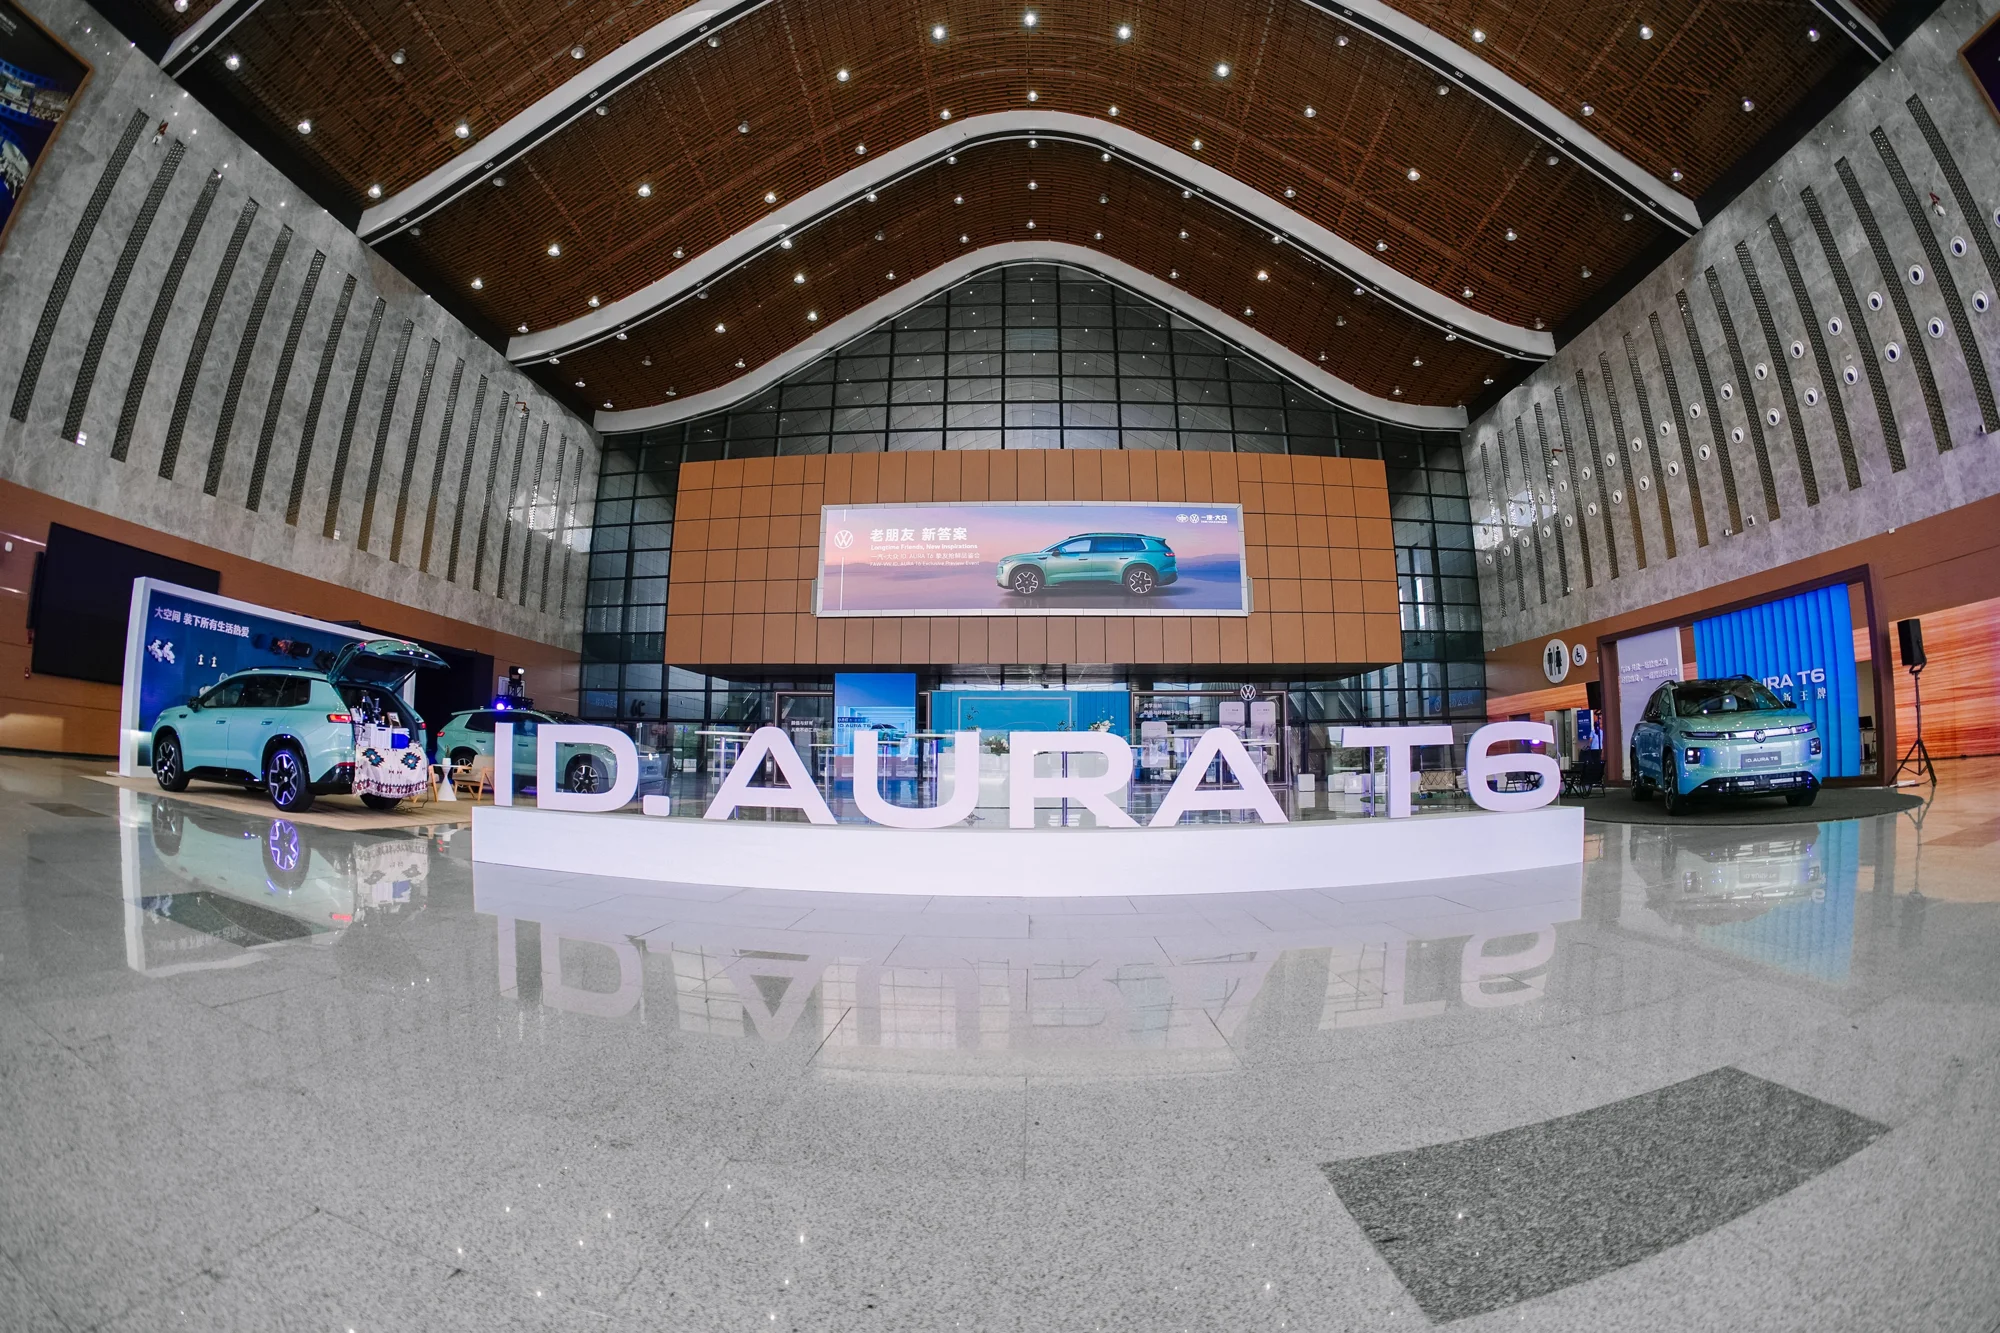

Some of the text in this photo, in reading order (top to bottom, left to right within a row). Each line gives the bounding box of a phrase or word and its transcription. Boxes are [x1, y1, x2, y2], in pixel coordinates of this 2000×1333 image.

[870, 527, 967, 542] 老朋友 新答案
[154, 606, 250, 638] 大空间 装下所有生活热爱
[1796, 667, 1825, 685] T6
[1770, 754, 1779, 762] T6
[1341, 721, 1561, 818] T6
